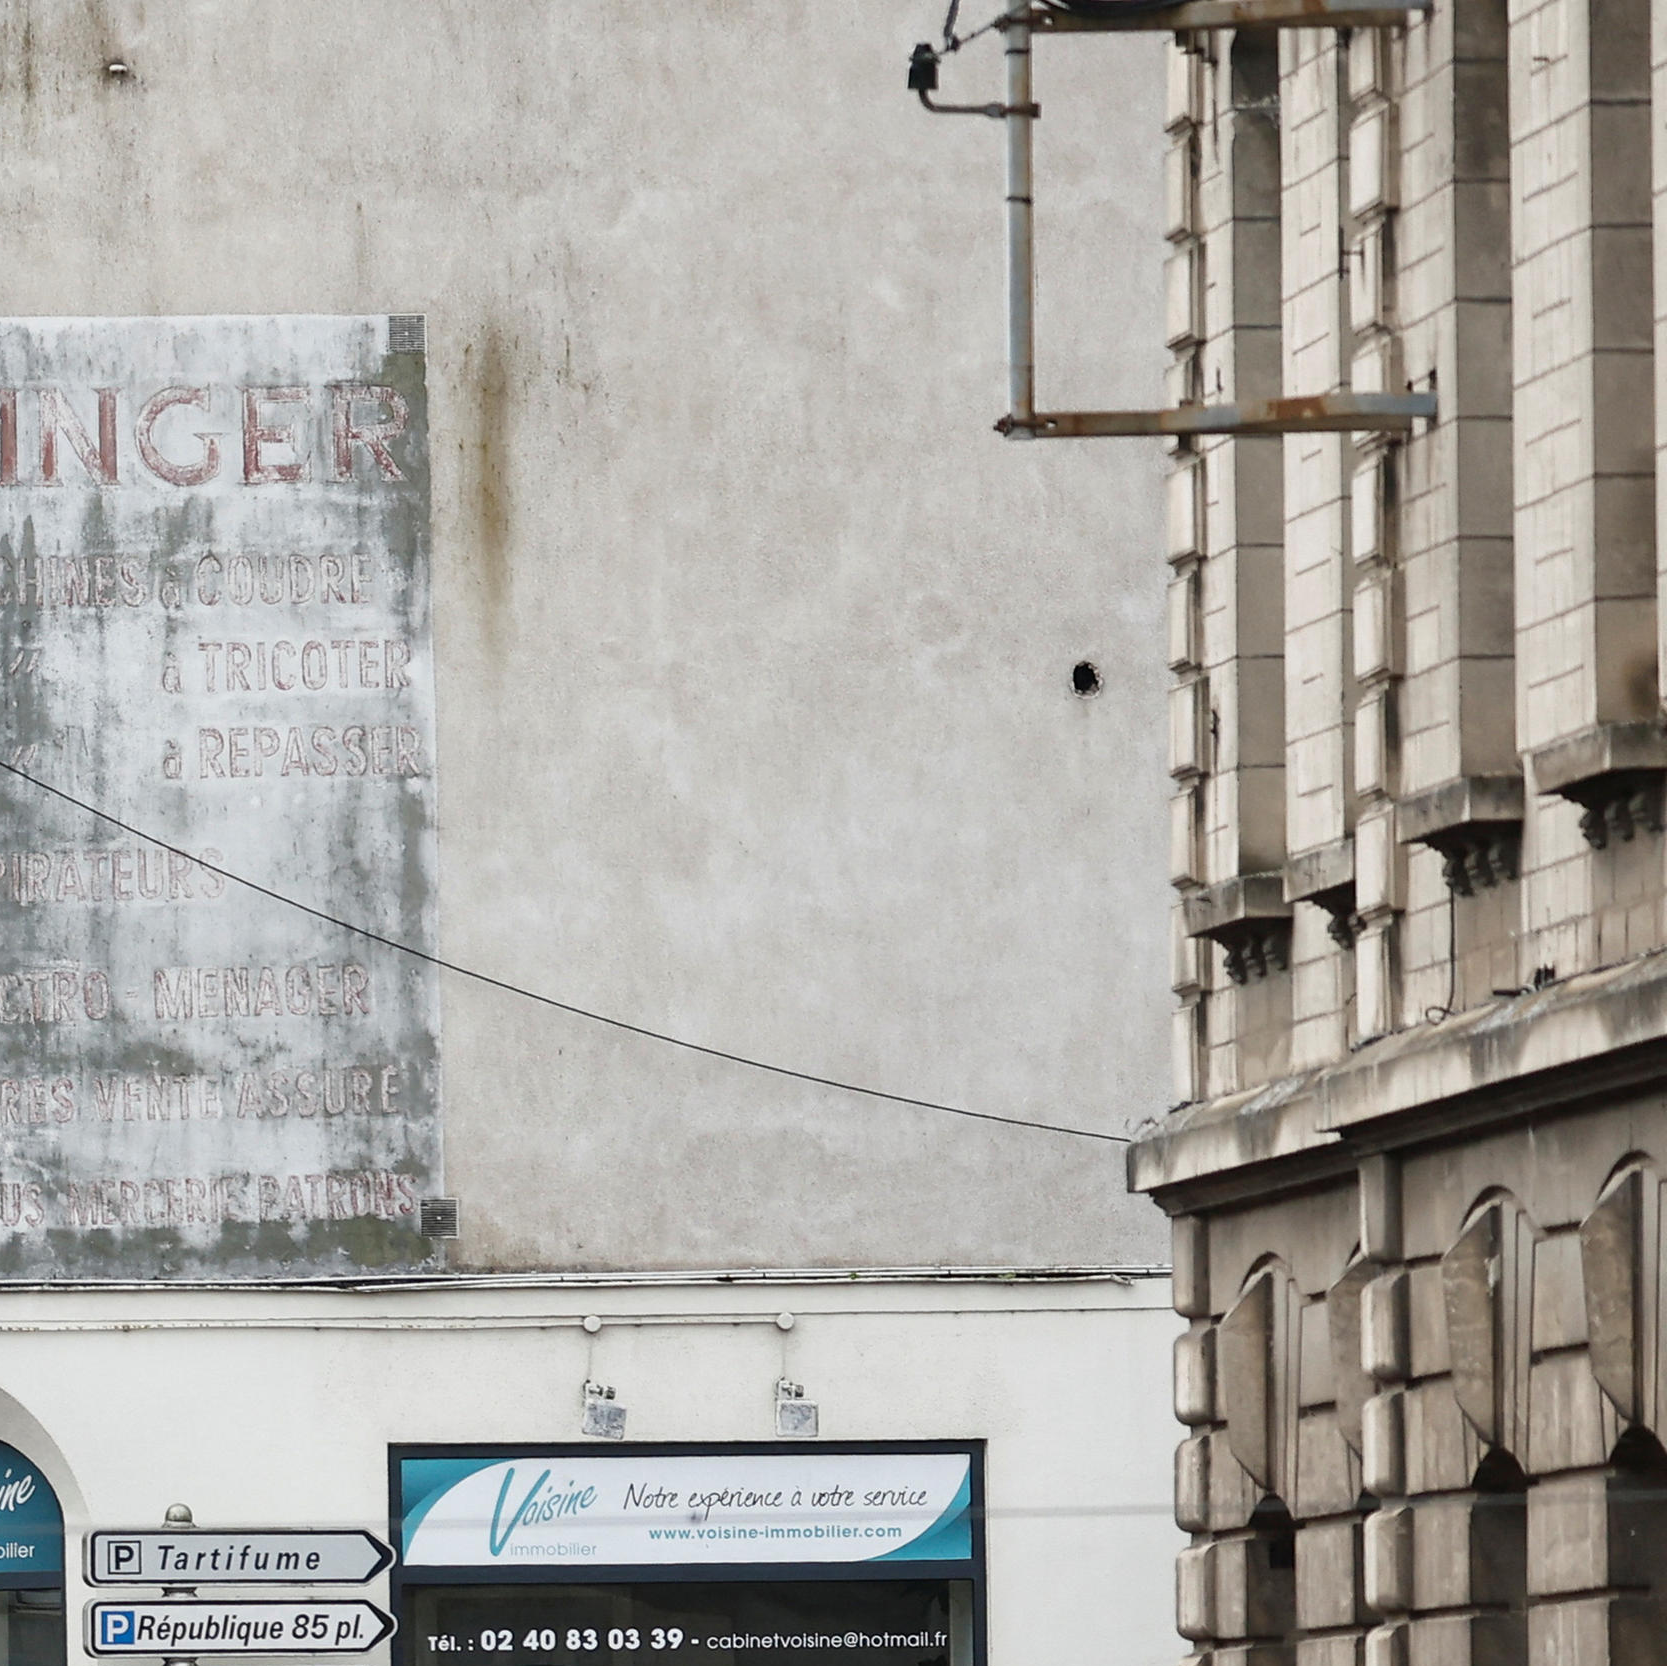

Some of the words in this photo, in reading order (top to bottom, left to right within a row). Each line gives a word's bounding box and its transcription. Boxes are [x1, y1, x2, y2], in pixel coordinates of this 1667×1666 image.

[195, 553, 373, 607] COUDRE
[162, 650, 181, 695] à
[198, 640, 412, 693] TRICOTER
[164, 739, 183, 781] à
[198, 726, 421, 780] REPASSER
[93, 1075, 218, 1122] VENTE
[237, 1064, 402, 1118] ASSURE
[68, 1176, 238, 1226] MERCERIE
[258, 1172, 419, 1222] PATRONS
[489, 1467, 599, 1557] Voisine
[623, 1483, 680, 1510] Notre
[688, 1487, 783, 1521] expérience
[791, 1486, 803, 1507] à
[812, 1485, 855, 1508] votre
[863, 1486, 928, 1508] service
[157, 1545, 321, 1571] Tartifume
[510, 1543, 596, 1557] immobilier
[649, 1525, 903, 1541] www.voisine-immobilier.com
[137, 1614, 284, 1646] République
[292, 1613, 329, 1639] 85
[335, 1614, 365, 1646] pl.
[428, 1635, 462, 1652] Tél.
[480, 1629, 514, 1651] 02
[522, 1629, 556, 1651] 40
[566, 1629, 599, 1650] 83
[608, 1628, 641, 1650] 03
[650, 1627, 684, 1650] 39
[707, 1631, 947, 1650] cabinetvoisine@hotmail.fr
